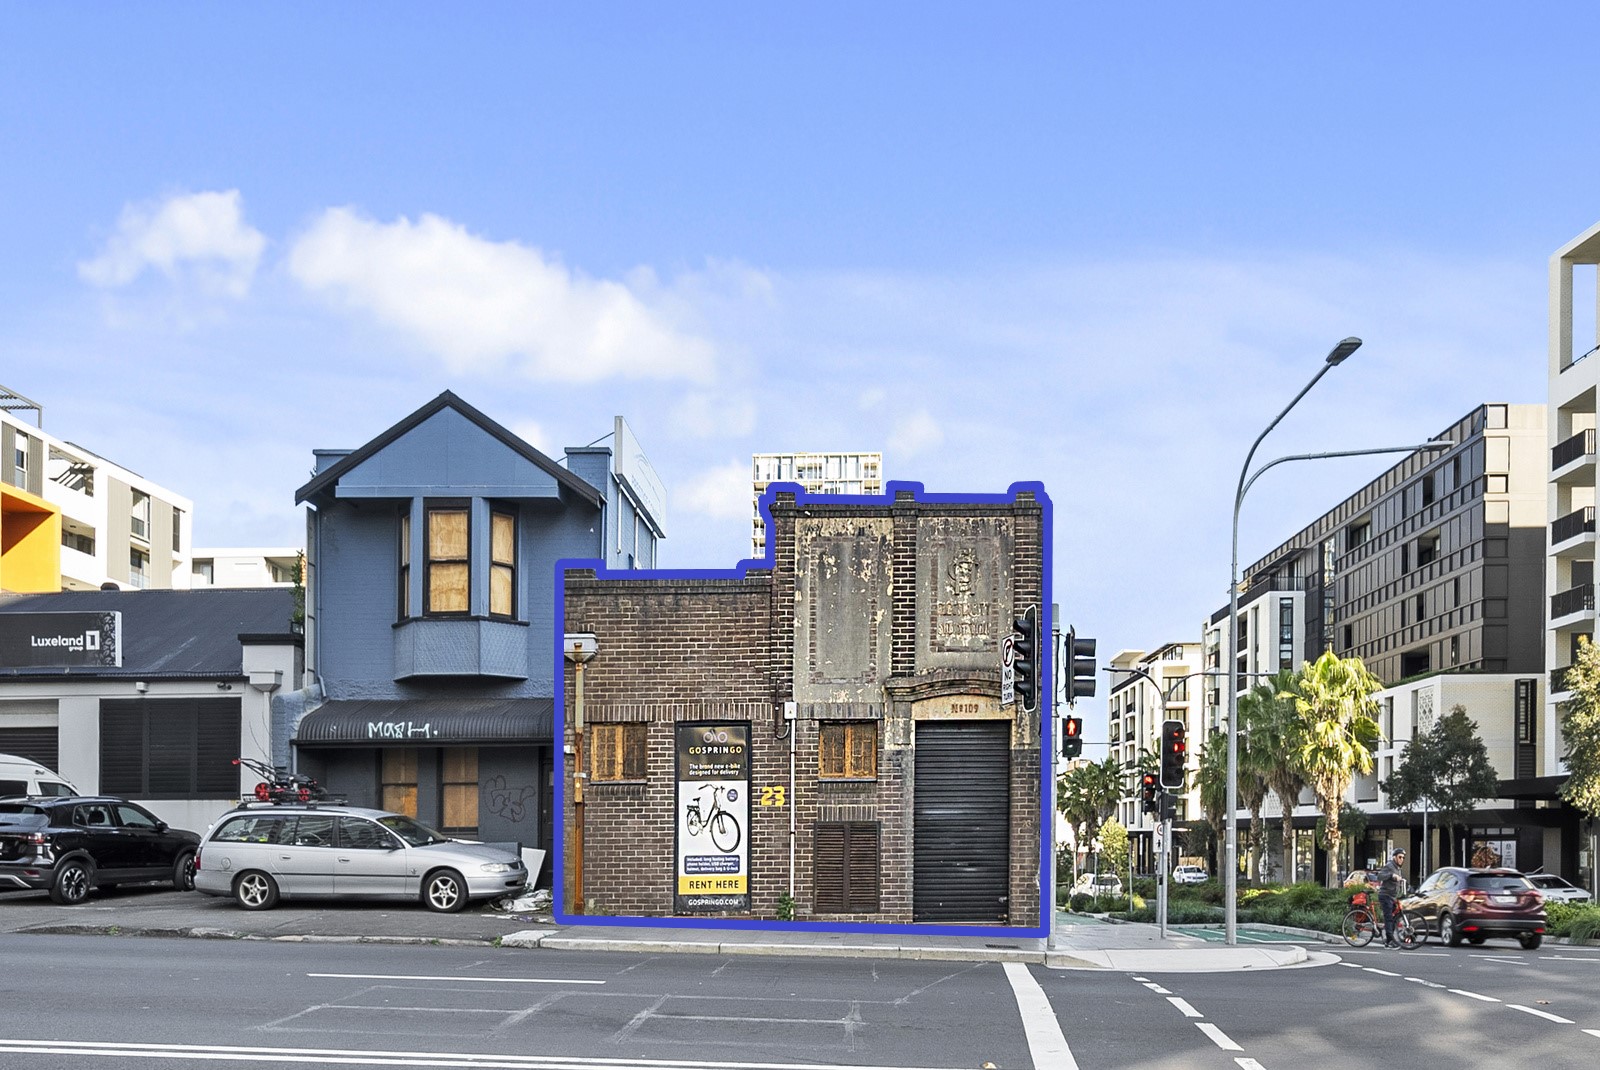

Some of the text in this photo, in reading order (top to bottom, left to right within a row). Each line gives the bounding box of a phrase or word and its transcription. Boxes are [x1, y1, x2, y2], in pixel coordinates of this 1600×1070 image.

[31, 634, 84, 647] Luxeland
[1004, 669, 1012, 681] NO
[689, 746, 742, 754] GOSPRINGO
[689, 769, 711, 777] designed
[761, 785, 785, 807] 23
[689, 880, 739, 889] RENT HERE
[688, 898, 739, 906] GOSPRINGO.COM
